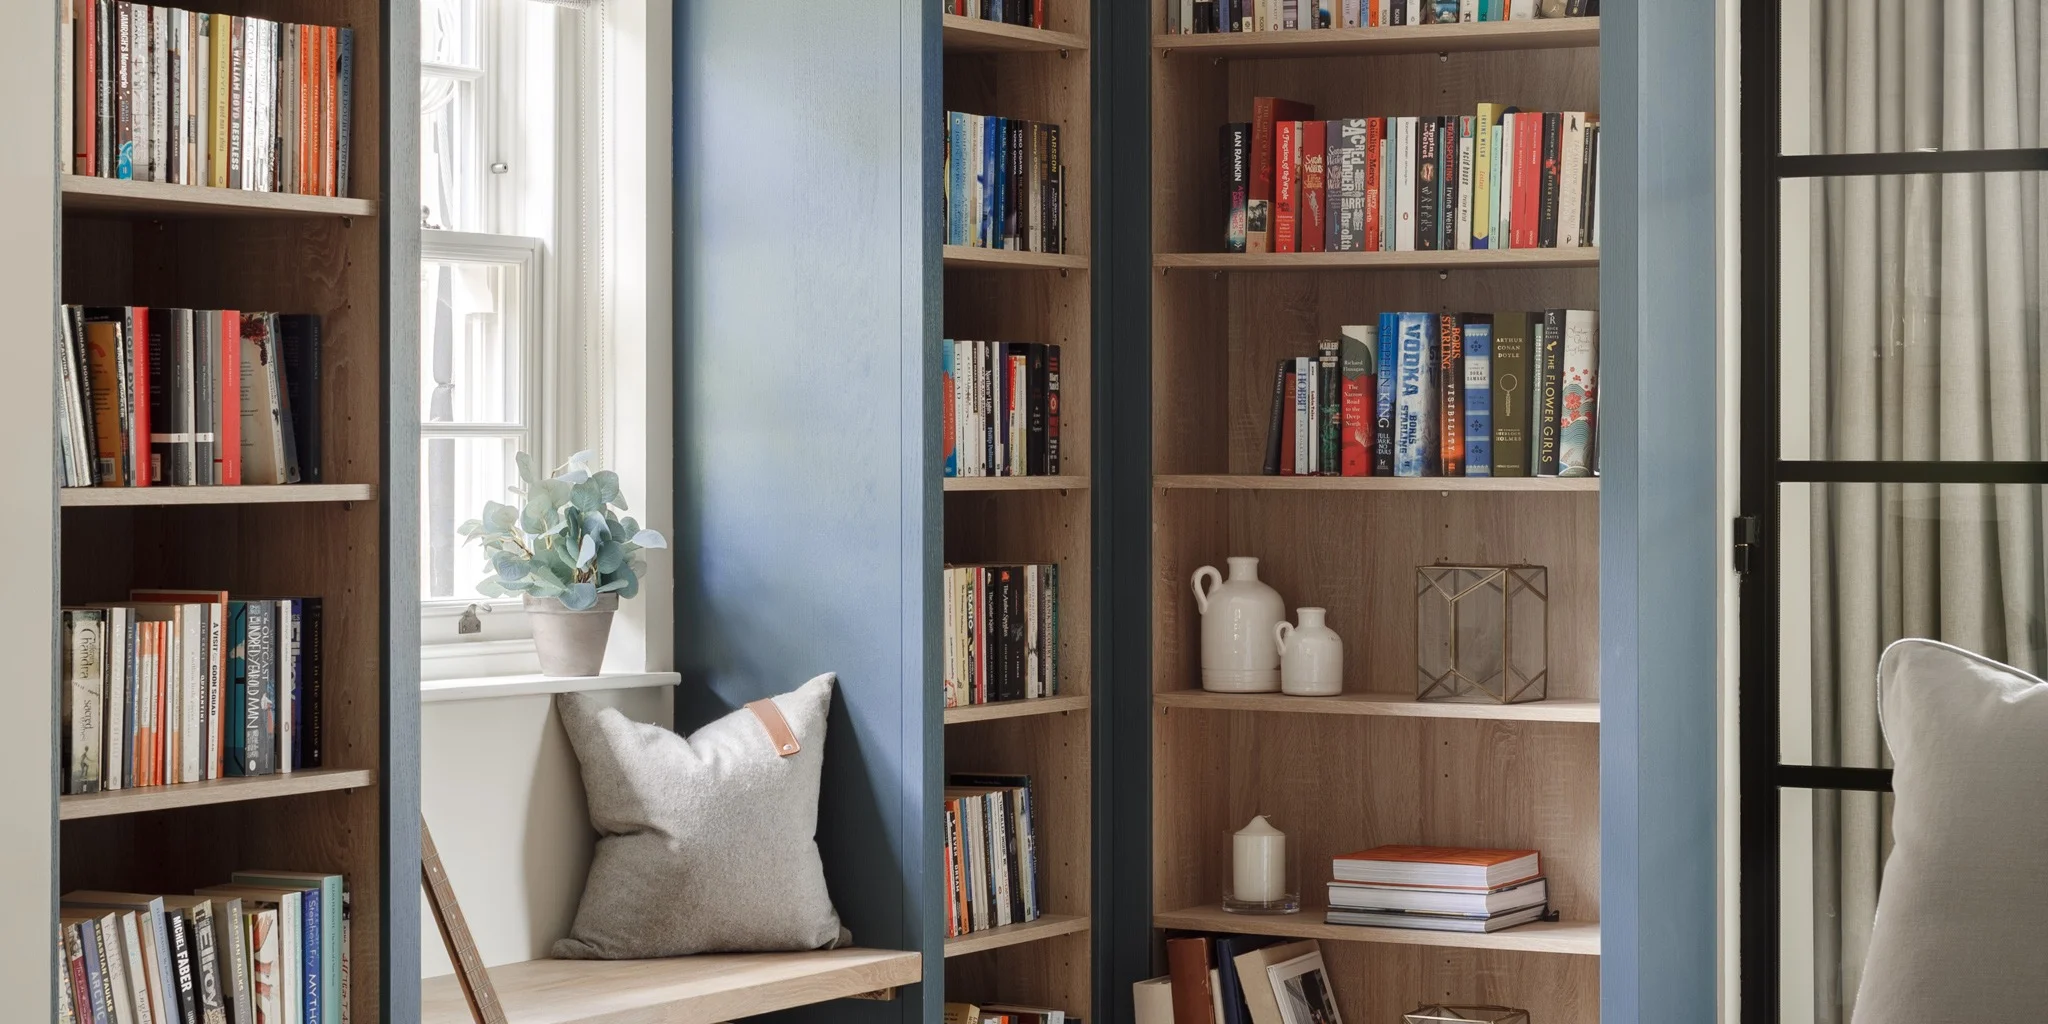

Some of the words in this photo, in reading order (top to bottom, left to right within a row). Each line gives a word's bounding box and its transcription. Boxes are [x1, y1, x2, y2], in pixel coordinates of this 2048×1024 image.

[120, 12, 129, 52] JAMRACH'S
[1262, 140, 1267, 150] OF
[1368, 120, 1377, 153] Quality
[1304, 164, 1323, 173] Waters
[1367, 159, 1376, 186] Mercy
[77, 311, 86, 364] REASONABLE
[1381, 325, 1391, 388] STEPHEN
[1442, 316, 1451, 369] STARLING
[1452, 327, 1460, 359] BORIS
[1402, 324, 1420, 397] VODKA
[1298, 373, 1307, 414] HOBBIT
[1378, 392, 1390, 428] KING
[1545, 375, 1556, 423] FLOWER
[1399, 405, 1408, 454] STARLING
[1408, 415, 1417, 445] BORIS
[1542, 428, 1553, 463] GIRLS
[79, 628, 96, 679] Chandra
[314, 666, 319, 675] in
[84, 700, 94, 729] sacred
[247, 697, 259, 729] MAN
[173, 916, 184, 950] MICHEL
[232, 908, 241, 956] SEBASTIAN
[308, 900, 317, 946] Stephen
[95, 923, 107, 975] SEBASTIAN
[103, 977, 113, 1012] FAULKS
[104, 924, 118, 981] FAULKS
[177, 950, 192, 992] FABER
[200, 928, 217, 1007] Ellroy
[308, 950, 316, 967] Fry
[91, 971, 105, 1020] ARCTIC
